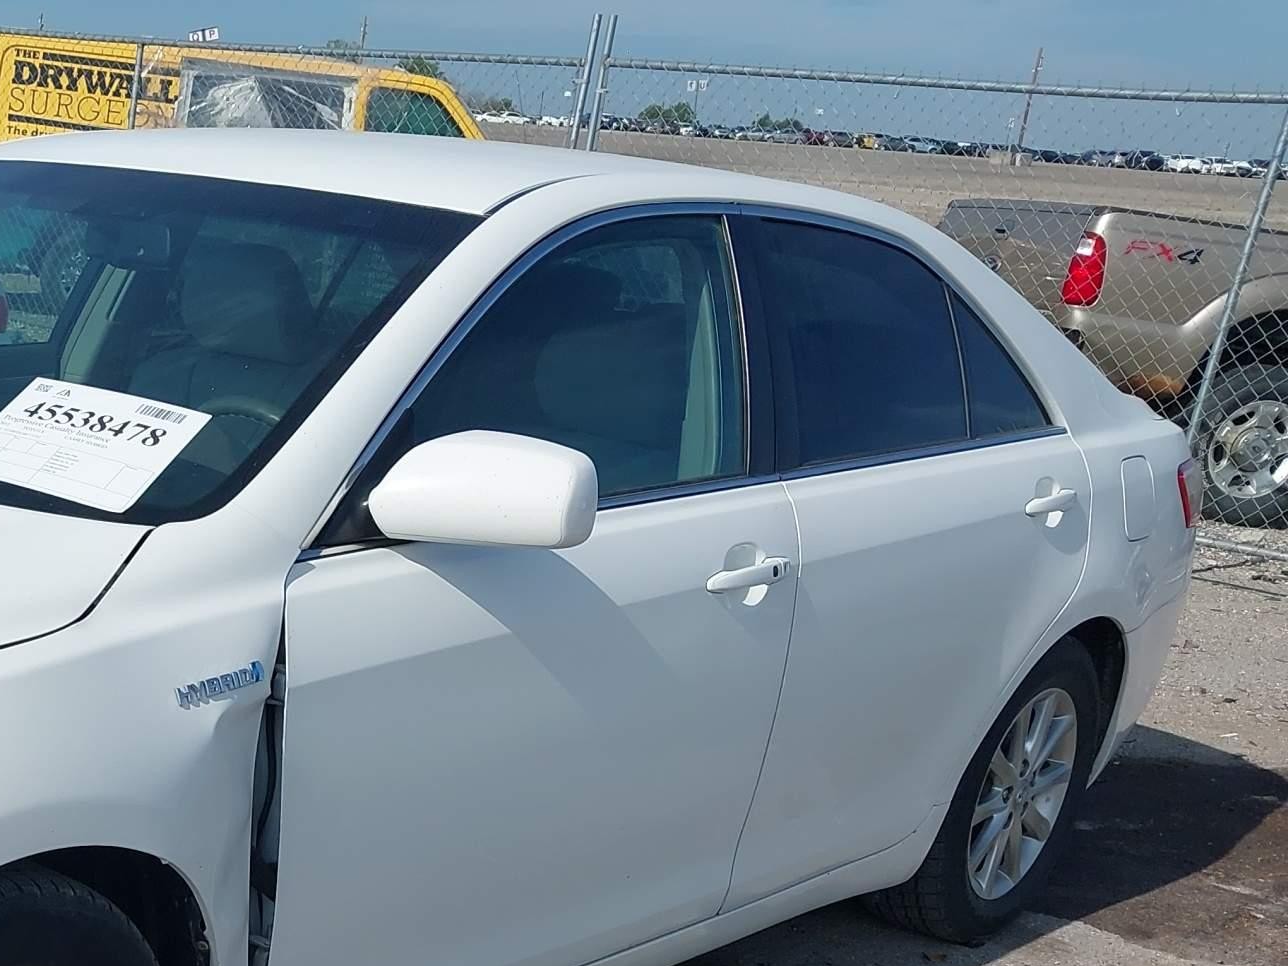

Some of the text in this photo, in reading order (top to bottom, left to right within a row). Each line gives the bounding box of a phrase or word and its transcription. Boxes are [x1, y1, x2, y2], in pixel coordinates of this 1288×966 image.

[14, 48, 40, 59] THE
[12, 60, 178, 104] DRYWALL
[7, 125, 28, 136] The
[1124, 239, 1204, 264] FX4
[23, 401, 167, 447] 45538478
[175, 667, 253, 709] HYBRID
